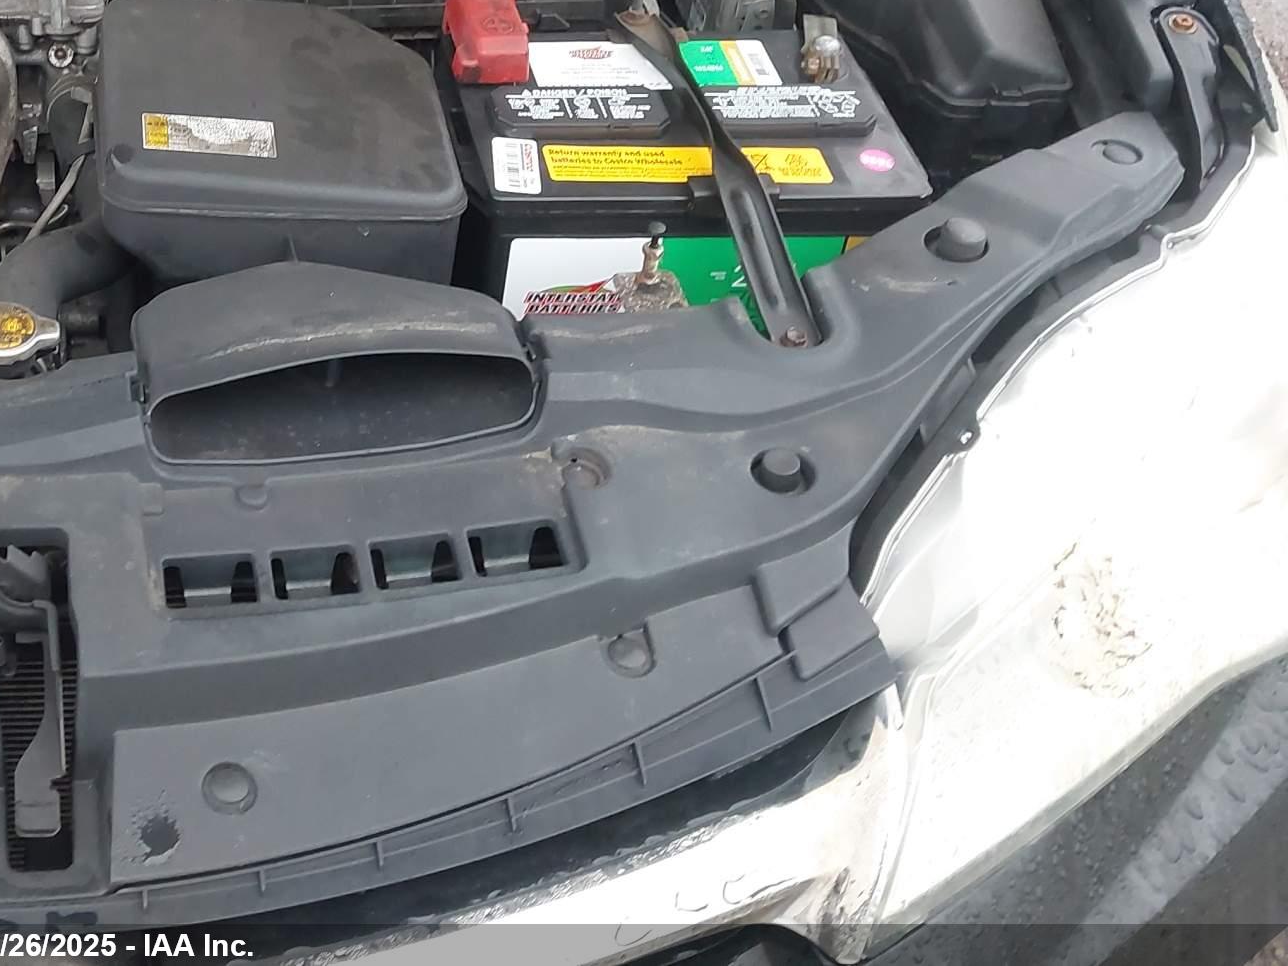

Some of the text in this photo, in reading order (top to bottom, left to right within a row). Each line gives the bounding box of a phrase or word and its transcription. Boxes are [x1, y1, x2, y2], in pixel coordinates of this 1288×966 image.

[548, 148, 665, 159] Return warranty and used
[551, 156, 592, 165] batteries
[593, 157, 602, 165] to
